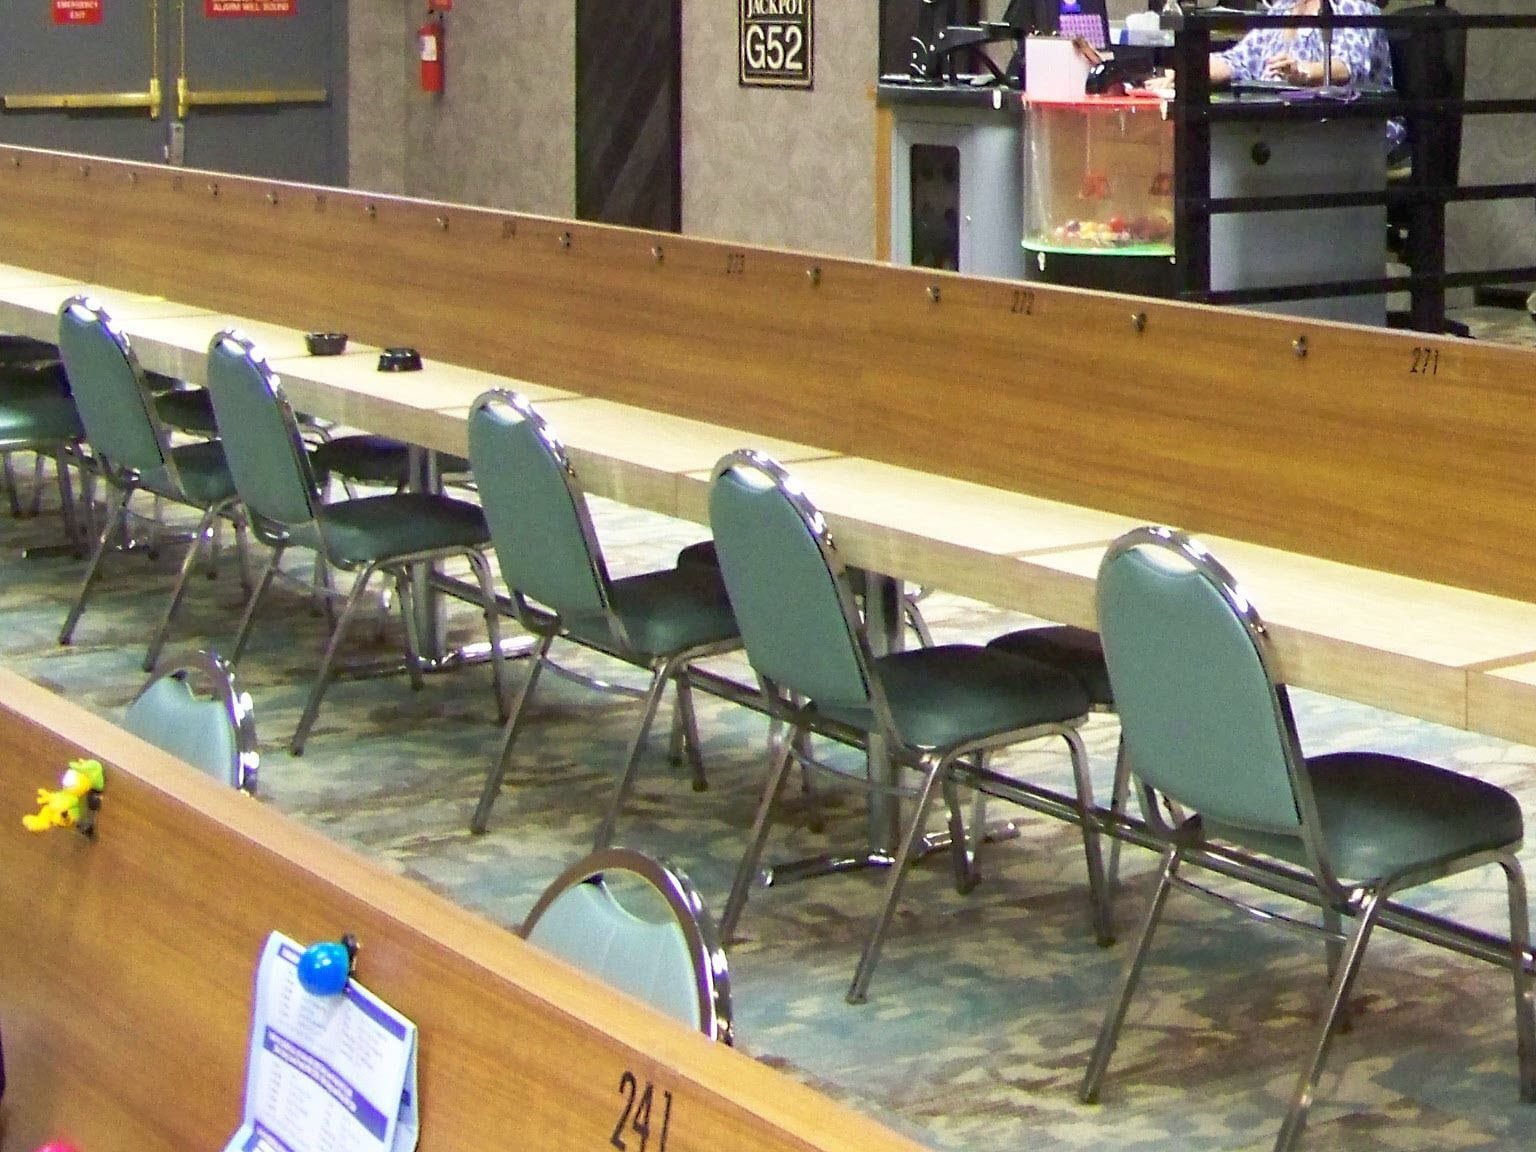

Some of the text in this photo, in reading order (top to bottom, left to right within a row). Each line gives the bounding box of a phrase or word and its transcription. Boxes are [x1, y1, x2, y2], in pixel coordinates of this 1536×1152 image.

[746, 24, 803, 70] G52
[1410, 347, 1439, 375] 271
[610, 1070, 672, 1152] 241
